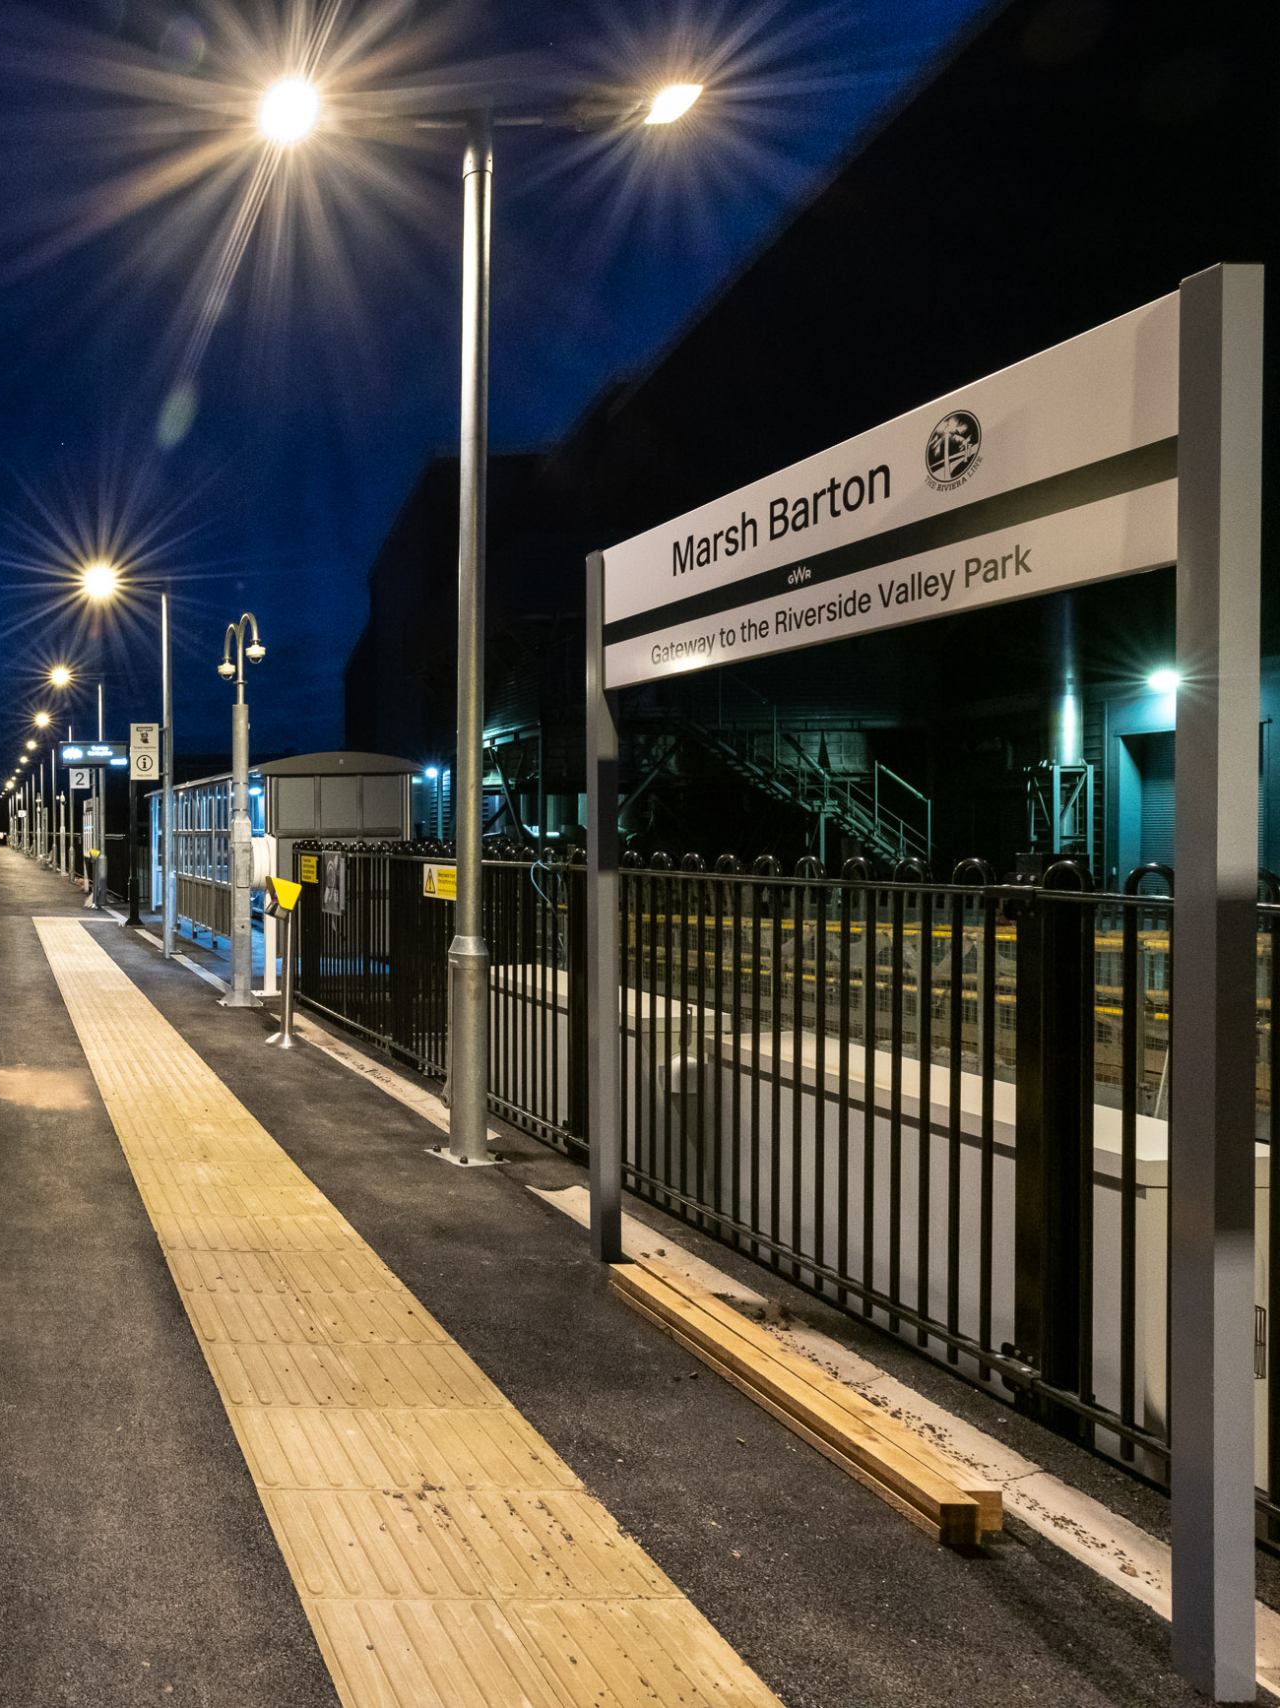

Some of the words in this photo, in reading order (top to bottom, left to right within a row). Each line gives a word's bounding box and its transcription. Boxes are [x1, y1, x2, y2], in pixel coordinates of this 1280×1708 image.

[936, 476, 968, 492] RIVIERA
[672, 511, 758, 577] Marsh
[769, 464, 891, 542] Barton
[787, 565, 812, 585] GWR
[651, 633, 716, 666] Gateway
[719, 627, 736, 649] to
[740, 618, 770, 644] the
[775, 589, 872, 635] Riverside
[878, 569, 956, 608] Valley
[964, 544, 1032, 588] Park
[75, 772, 85, 786] 2
